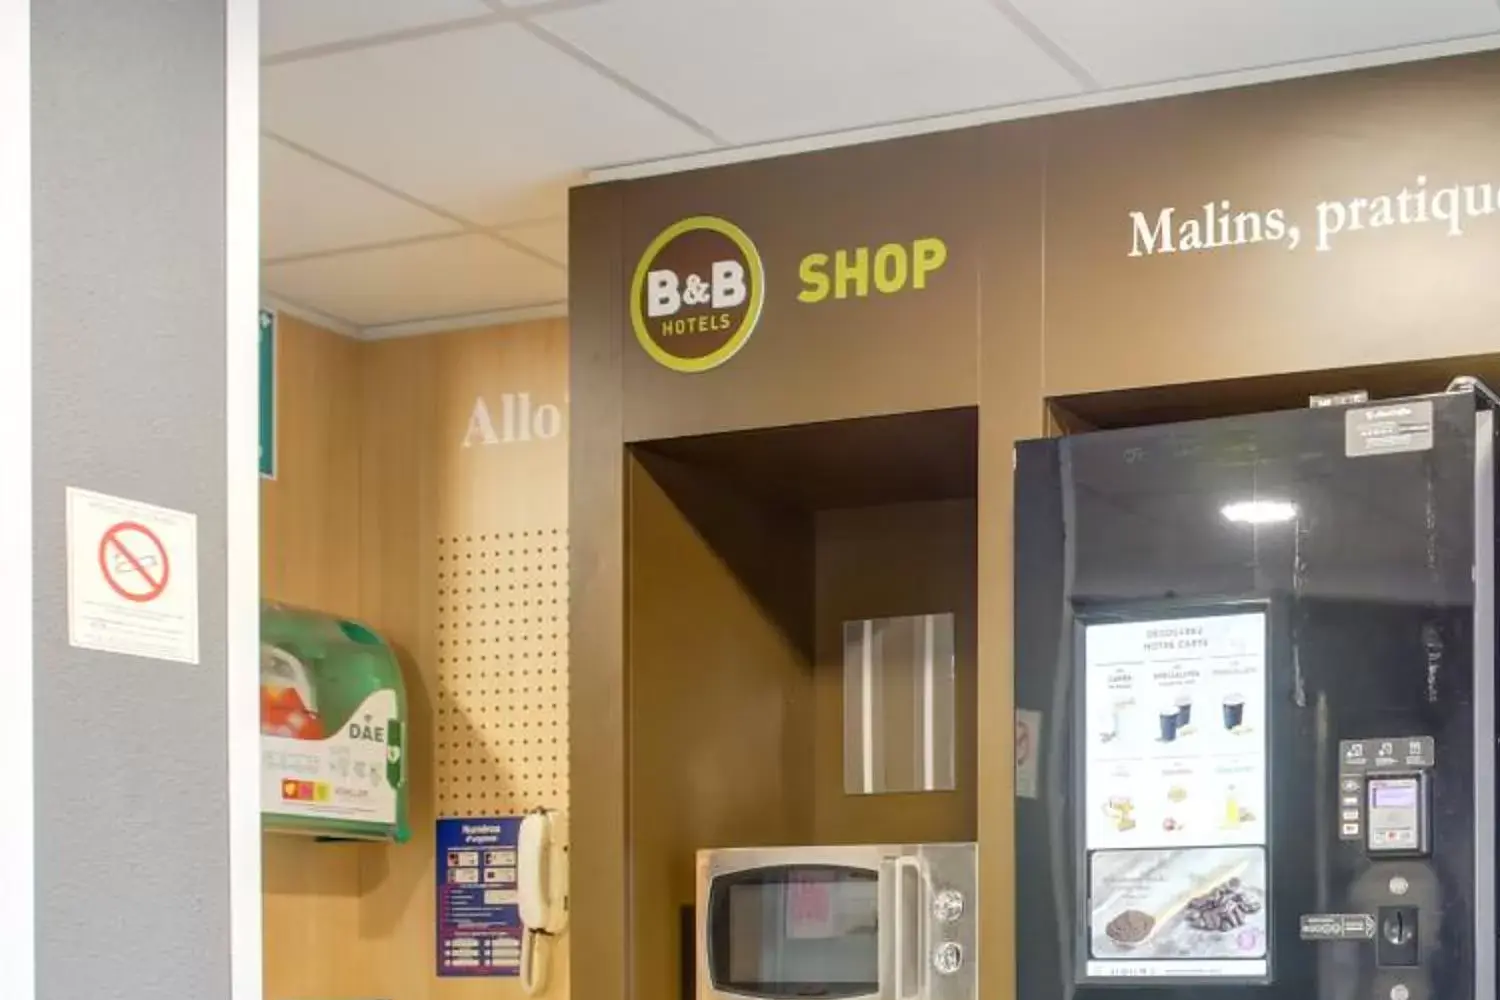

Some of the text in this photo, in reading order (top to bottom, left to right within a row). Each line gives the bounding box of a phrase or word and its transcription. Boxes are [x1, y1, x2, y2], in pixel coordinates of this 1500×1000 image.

[1129, 203, 1301, 256] Malins,
[647, 260, 747, 317] B&B
[798, 237, 948, 304] SHOP
[662, 313, 731, 336] HOTELS
[349, 723, 385, 743] DAE
